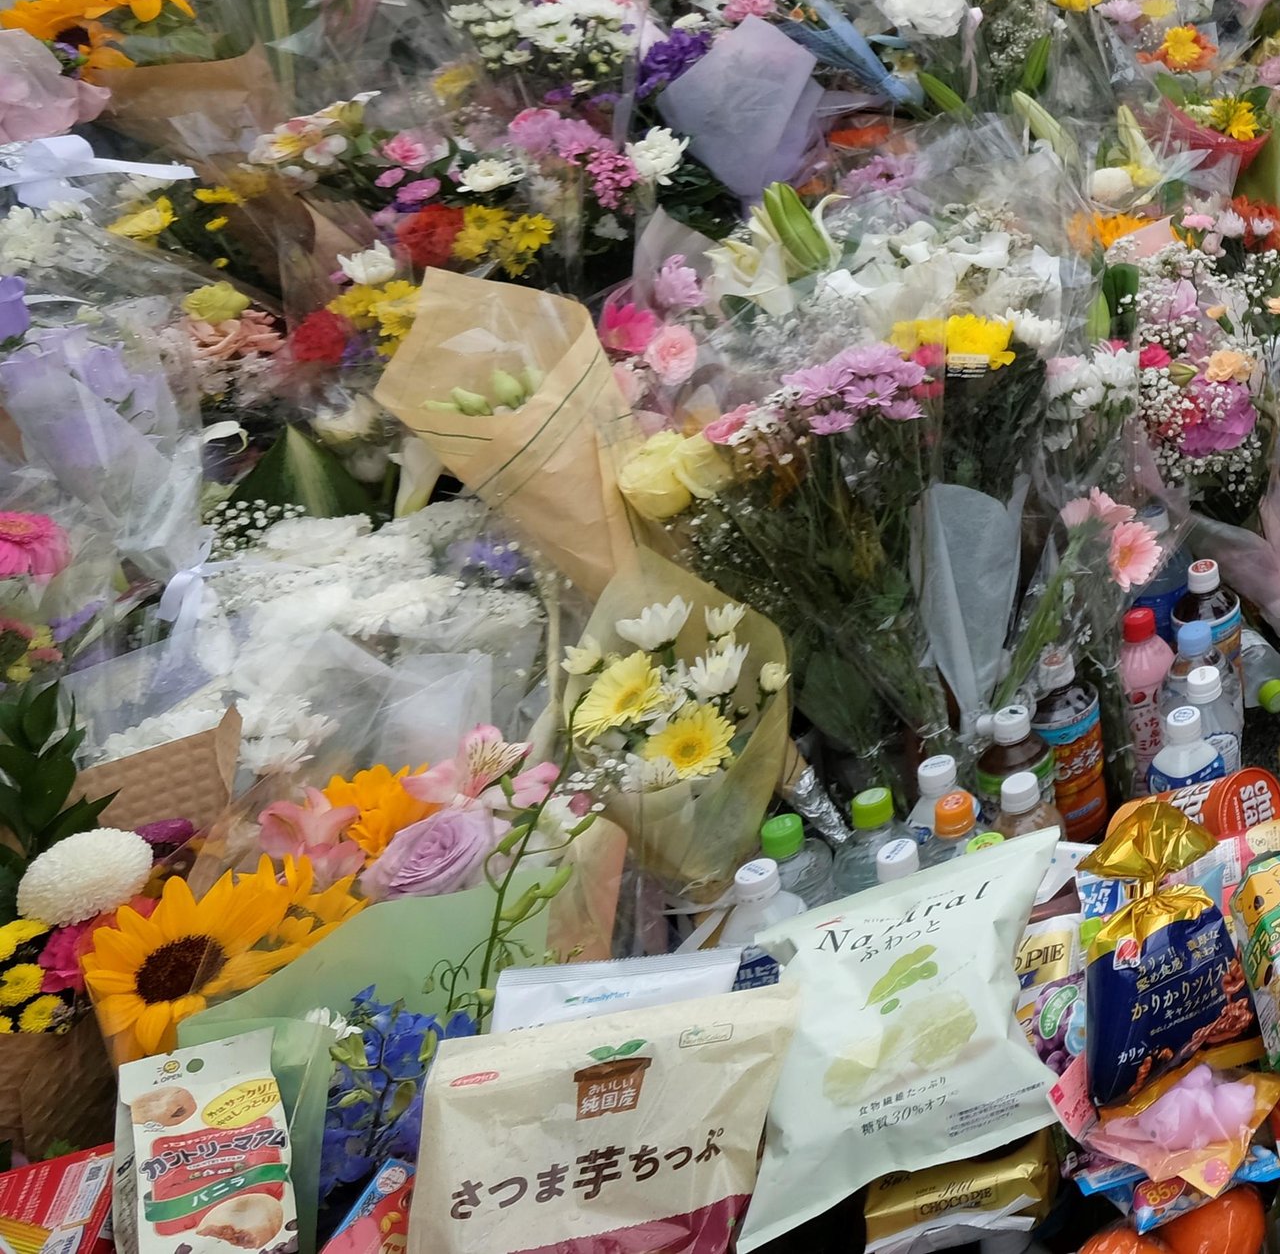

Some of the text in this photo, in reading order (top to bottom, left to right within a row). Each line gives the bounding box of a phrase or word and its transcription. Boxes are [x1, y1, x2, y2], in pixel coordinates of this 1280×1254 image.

[859, 919, 941, 963] ふわっと
[1025, 943, 1066, 970] PIE
[1131, 956, 1233, 1022] かりかりツイスト
[160, 1073, 183, 1084] OPEN
[588, 1077, 634, 1094] おいしい
[579, 1089, 636, 1115] 純国産
[139, 1128, 288, 1182] カントリーマアム
[191, 1175, 246, 1207] バニラ
[919, 1192, 968, 1216] CHOCO
[970, 1187, 993, 1202] PIE
[1147, 1180, 1180, 1207] 85g
